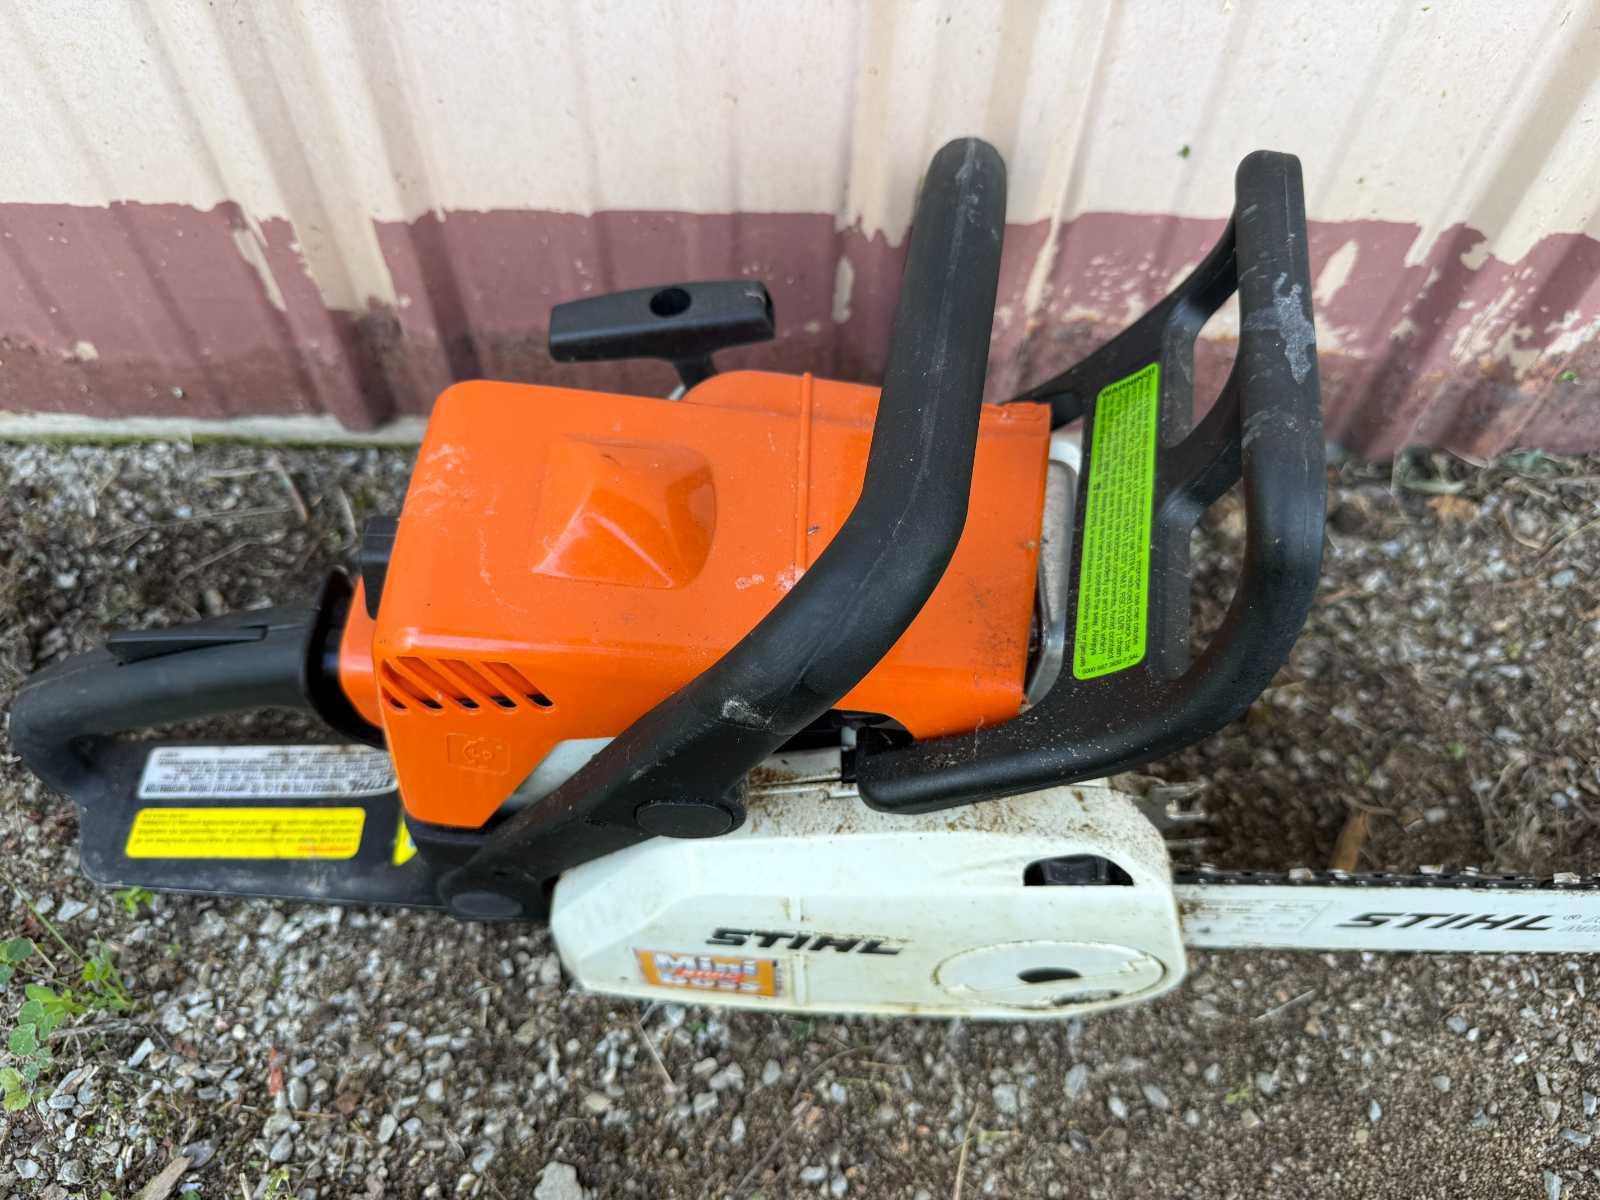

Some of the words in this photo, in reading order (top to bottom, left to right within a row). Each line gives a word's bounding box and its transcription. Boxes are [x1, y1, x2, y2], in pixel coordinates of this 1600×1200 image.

[1336, 913, 1552, 930] STIHL
[706, 927, 903, 955] STIHL
[655, 953, 757, 975] Mini
